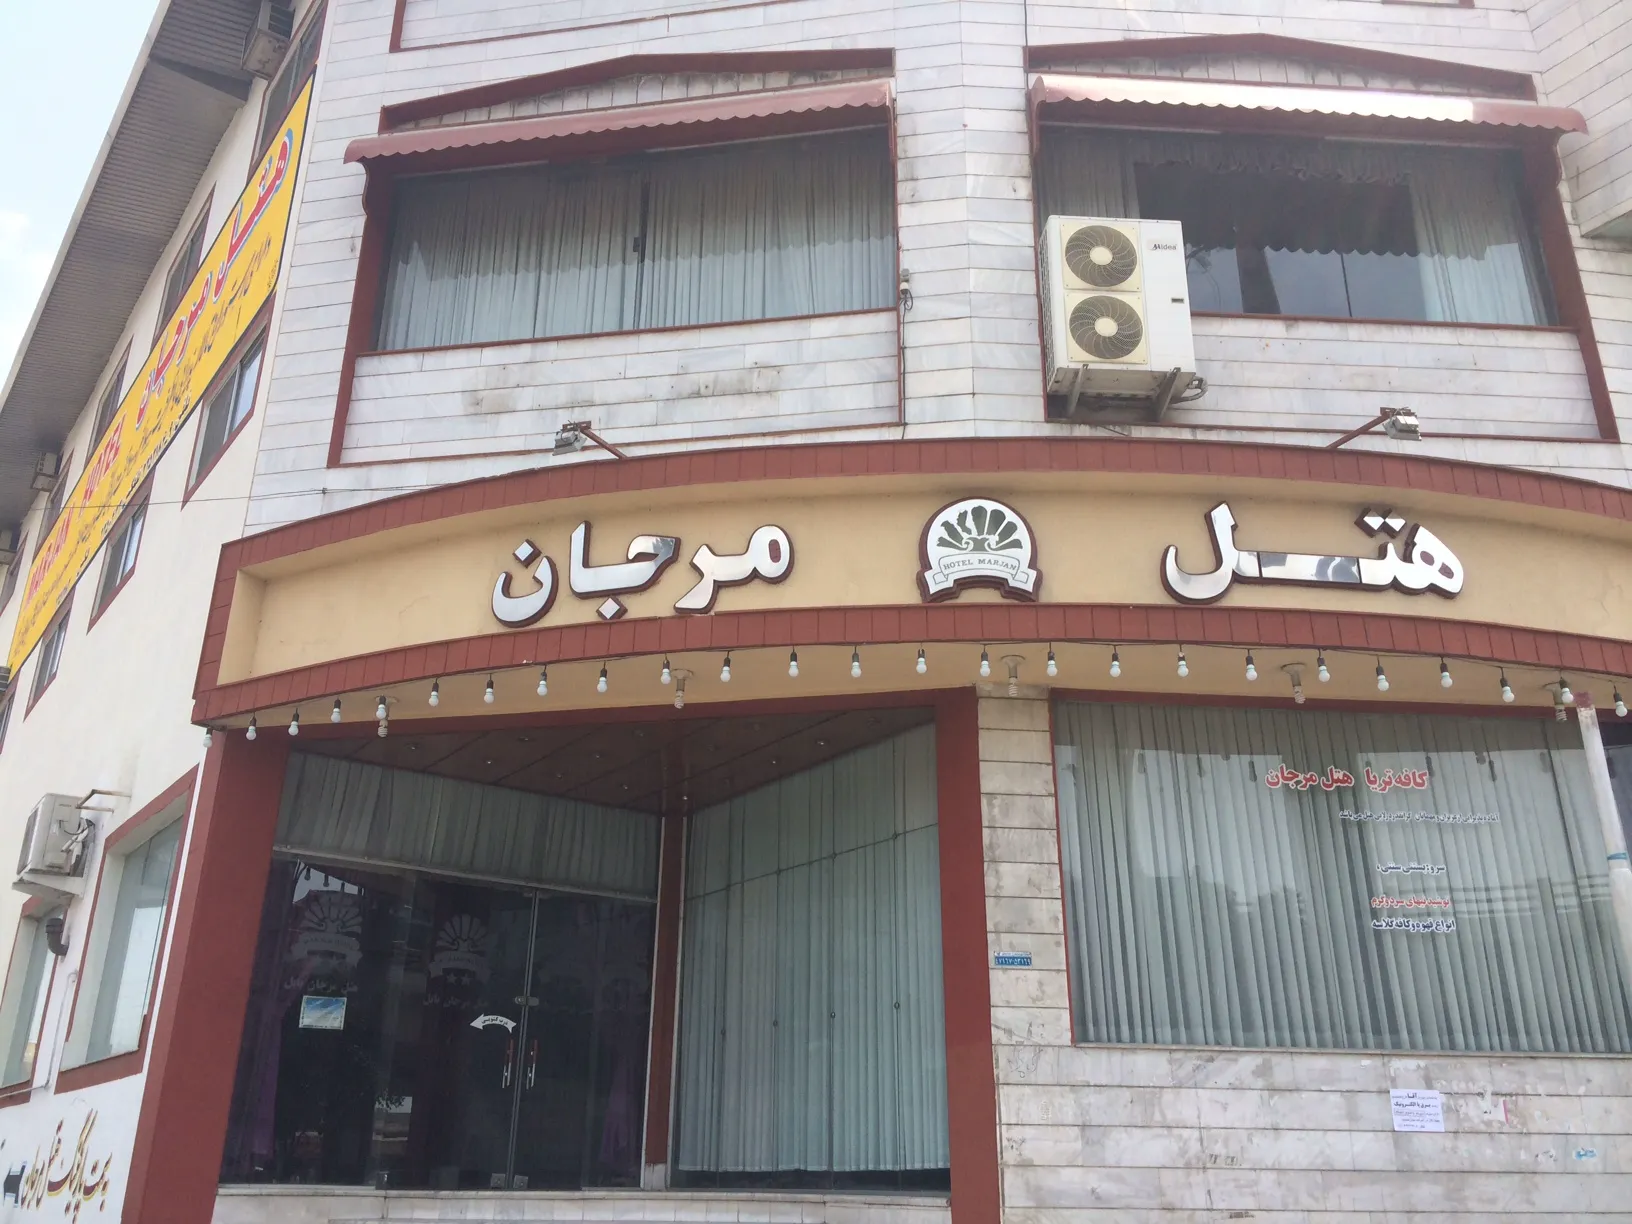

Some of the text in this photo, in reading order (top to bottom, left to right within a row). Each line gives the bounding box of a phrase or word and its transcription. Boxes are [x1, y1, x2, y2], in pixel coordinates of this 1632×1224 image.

[213, 127, 294, 305] هتل
[1151, 243, 1177, 251] Midea
[136, 270, 214, 432] مرجان
[491, 500, 1464, 628] هتل مرجان
[943, 559, 1017, 571] HOTEL MARJAN
[1265, 763, 1319, 789] مرجان
[1320, 765, 1355, 790] هتل
[1434, 918, 1456, 931] انواع
